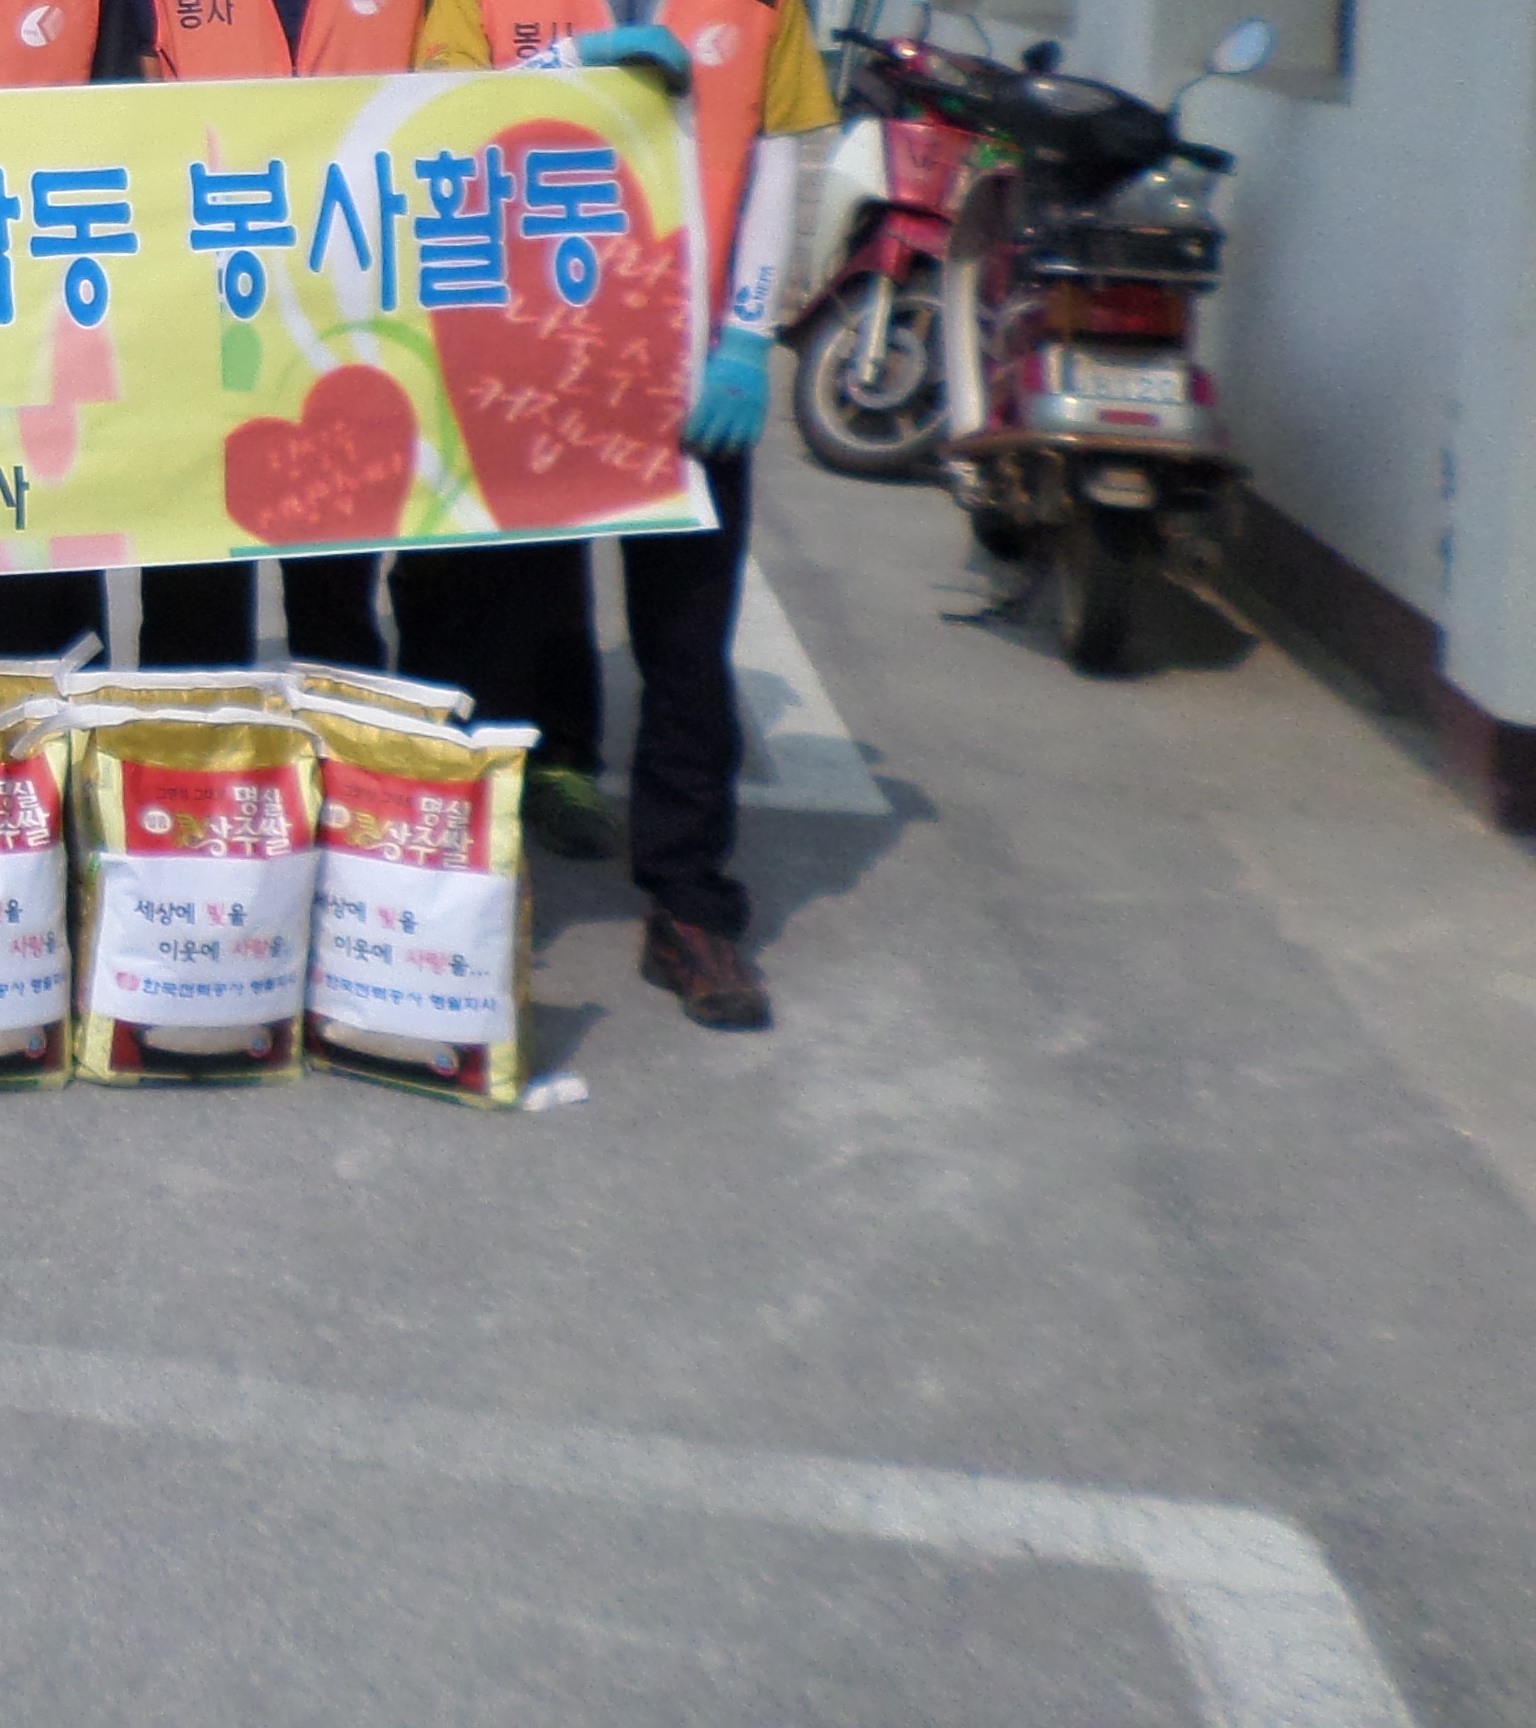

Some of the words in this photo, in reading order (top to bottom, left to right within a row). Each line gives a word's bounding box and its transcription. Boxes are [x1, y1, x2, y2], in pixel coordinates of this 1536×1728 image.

[188, 144, 630, 322] 봉사활동
[232, 785, 285, 817] 명실
[134, 899, 197, 925] 세상에
[159, 938, 221, 964] 이웃에
[334, 934, 394, 964] 이웃에
